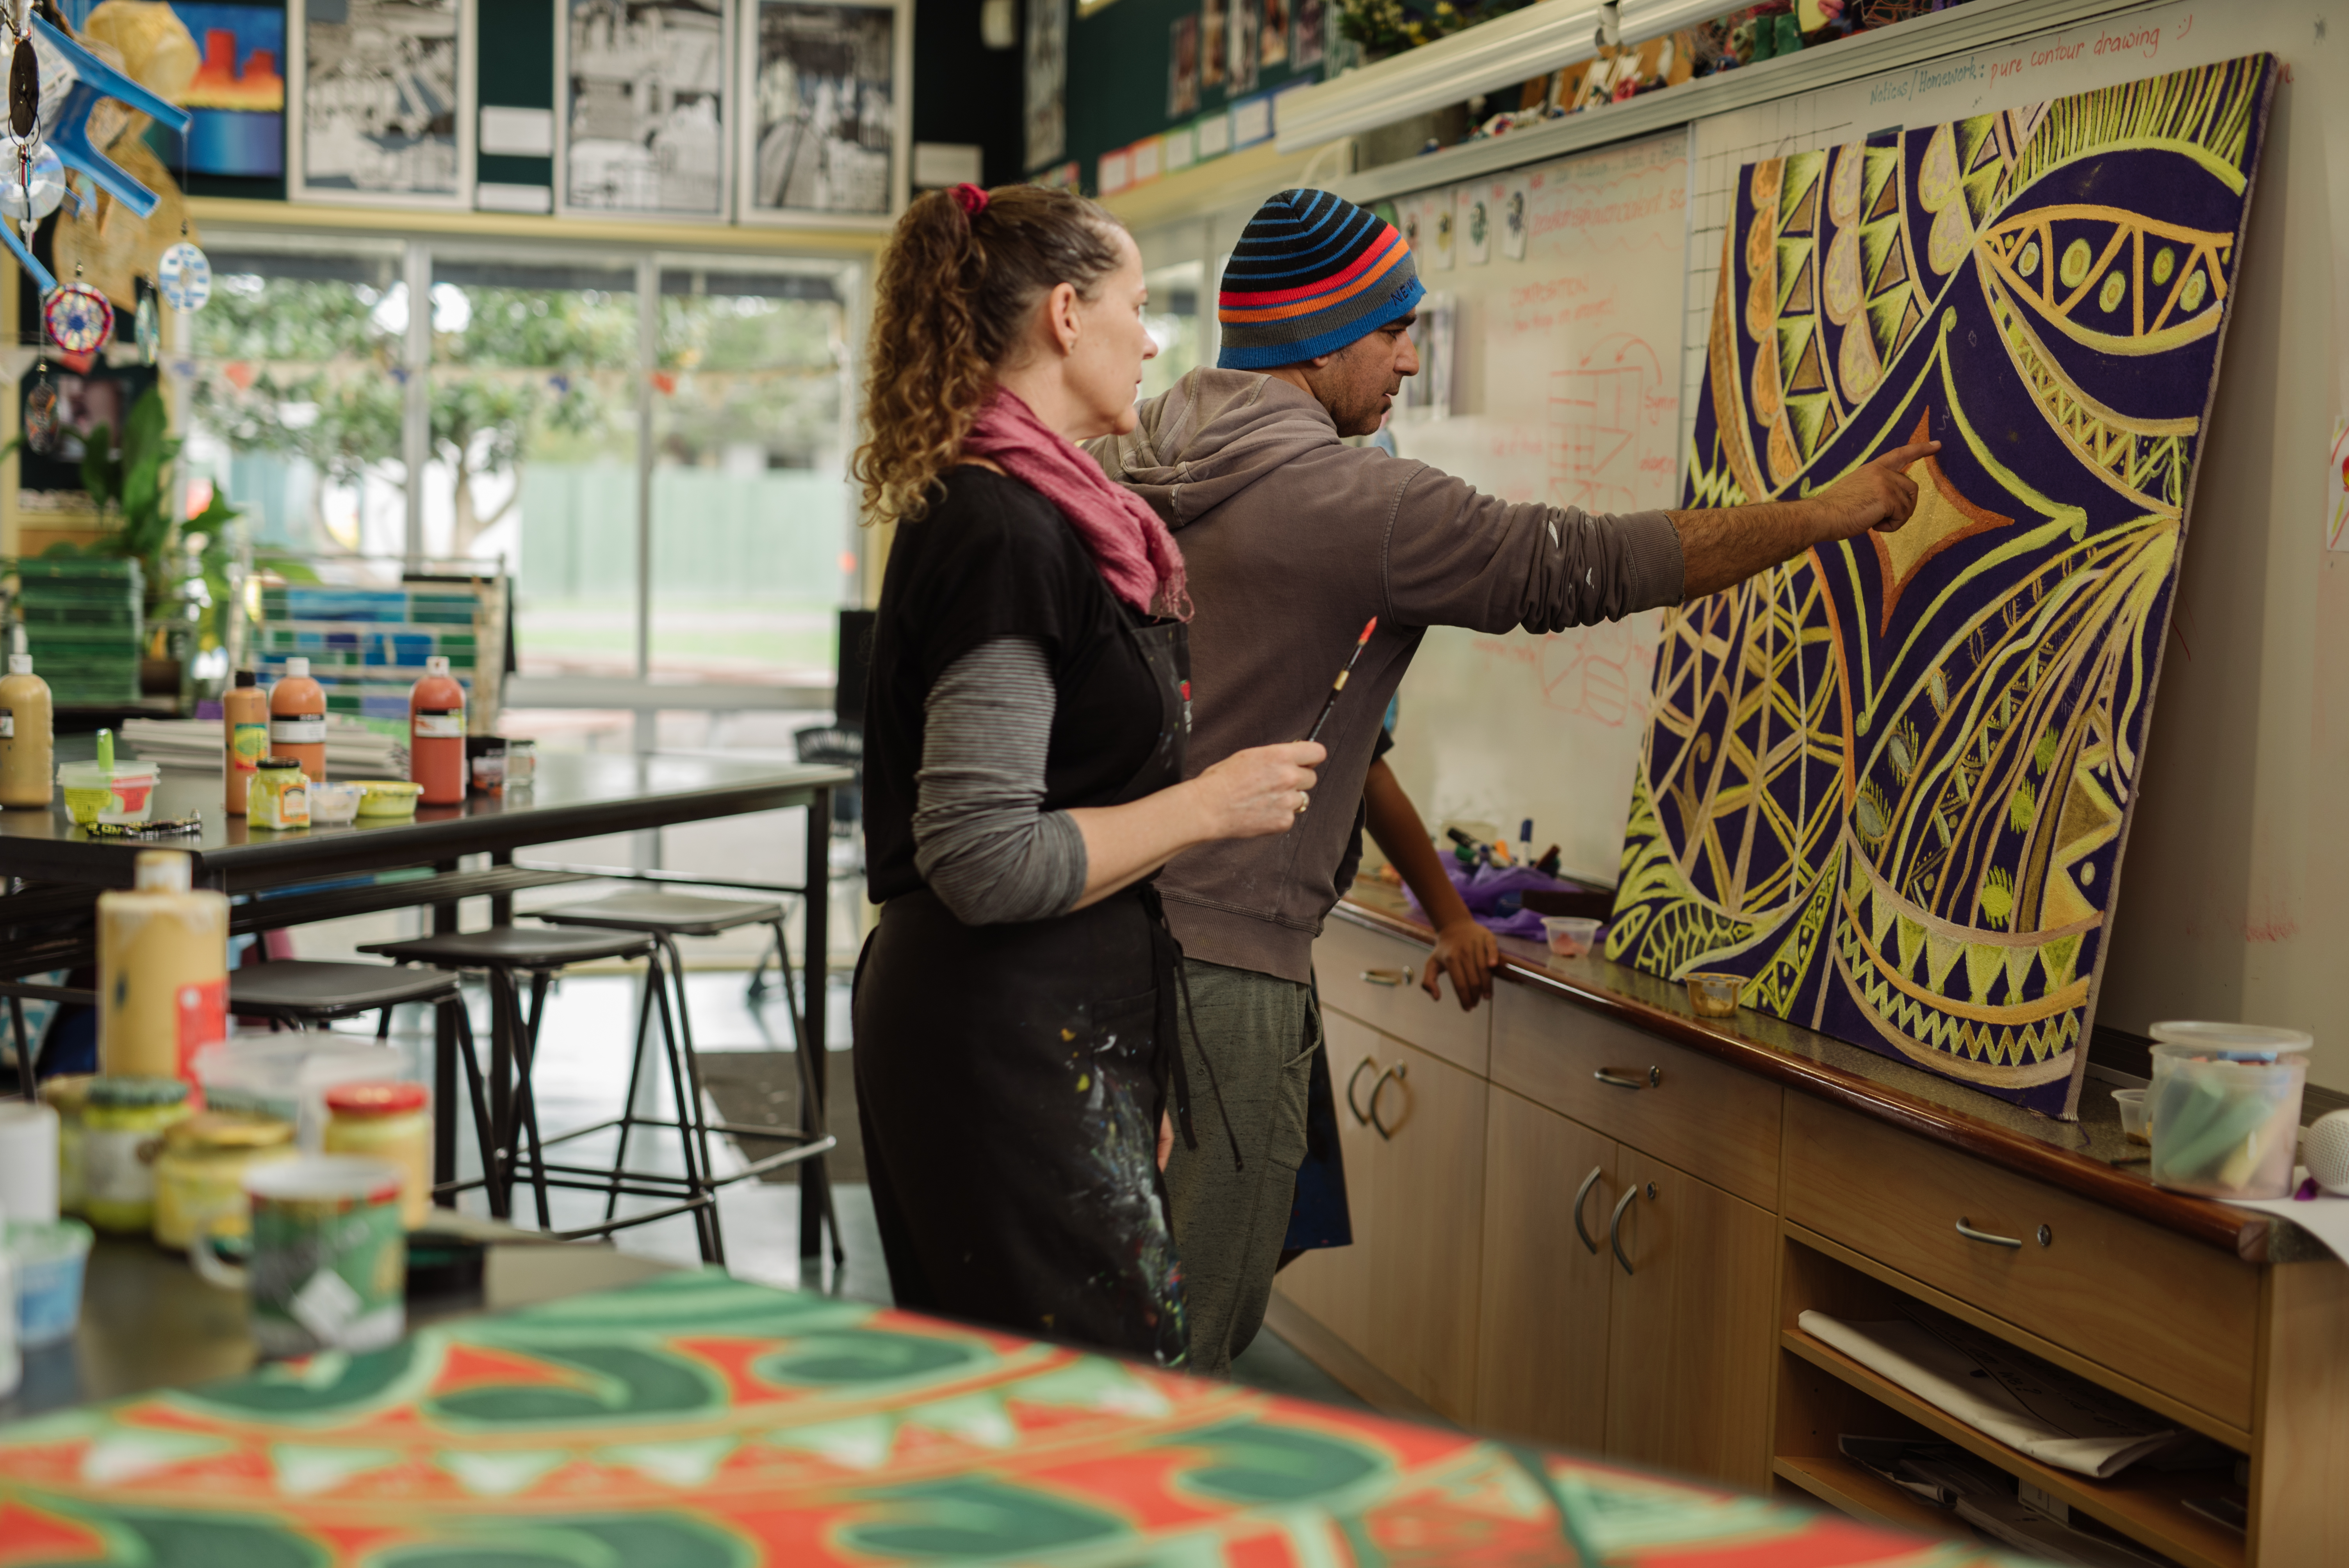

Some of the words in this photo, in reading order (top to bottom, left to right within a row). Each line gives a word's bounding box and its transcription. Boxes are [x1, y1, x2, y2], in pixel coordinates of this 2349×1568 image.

[1990, 58, 2023, 89] pure
[2030, 36, 2085, 67] contour
[2094, 26, 2160, 58] drawing
[1390, 275, 1415, 306] NEW
